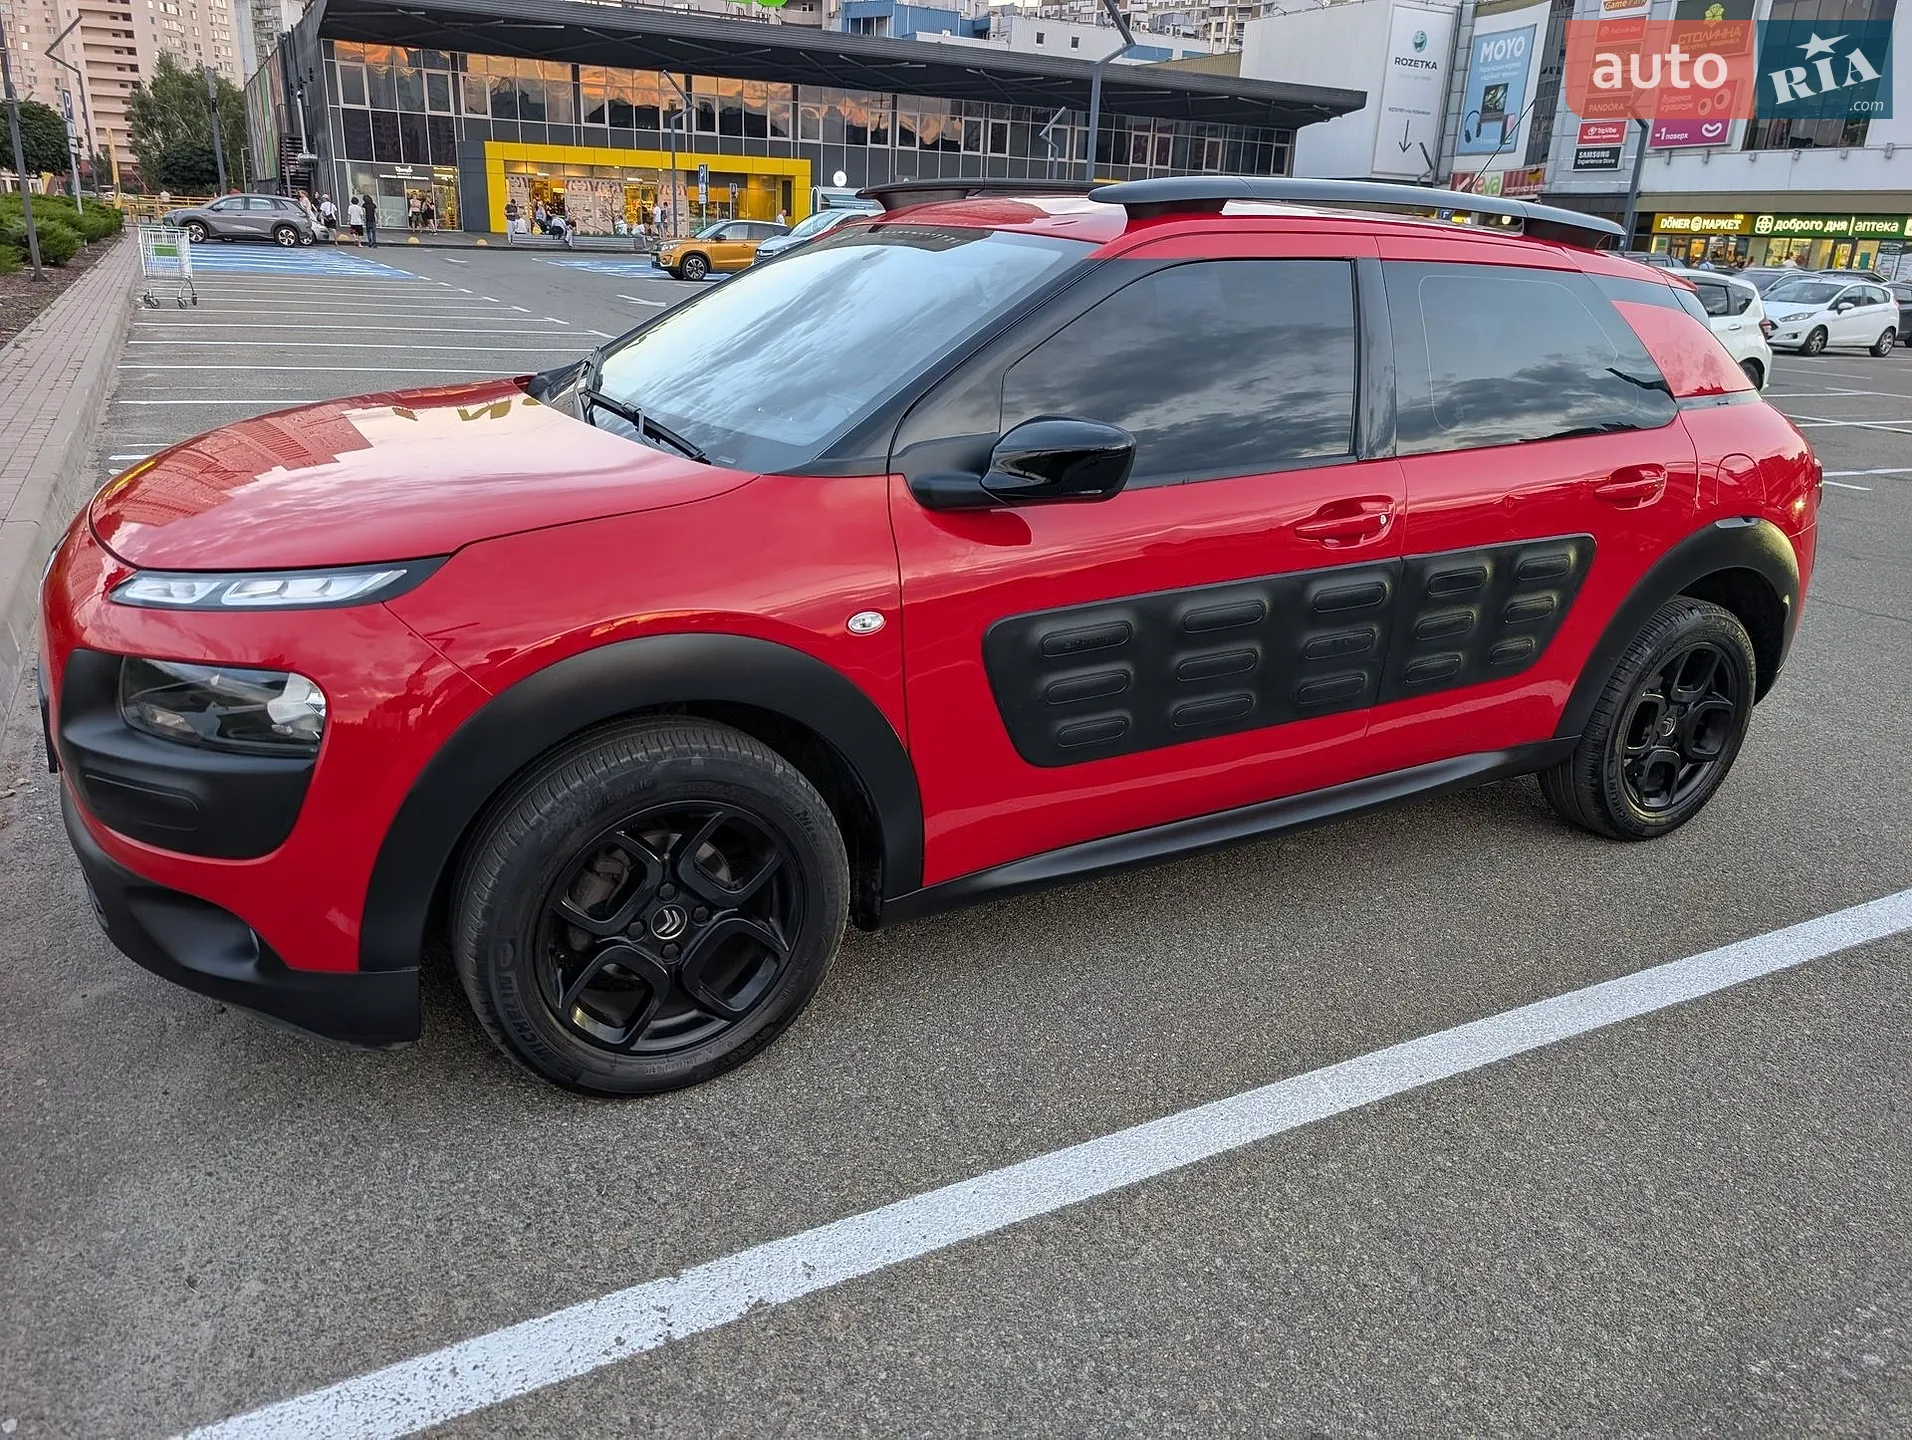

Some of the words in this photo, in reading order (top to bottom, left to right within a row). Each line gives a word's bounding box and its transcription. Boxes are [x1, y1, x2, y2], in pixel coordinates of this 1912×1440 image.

[1480, 35, 1525, 63] MOYO
[1394, 57, 1438, 70] ROZETKA
[1665, 132, 1689, 141] поверх
[1578, 150, 1610, 158] SAMSUNG
[1660, 216, 1690, 229] DÖNER
[1701, 218, 1742, 230] МАРКЕТ
[1773, 218, 1823, 233] доброго
[1824, 219, 1849, 233] дня
[1854, 221, 1900, 232] аптека
